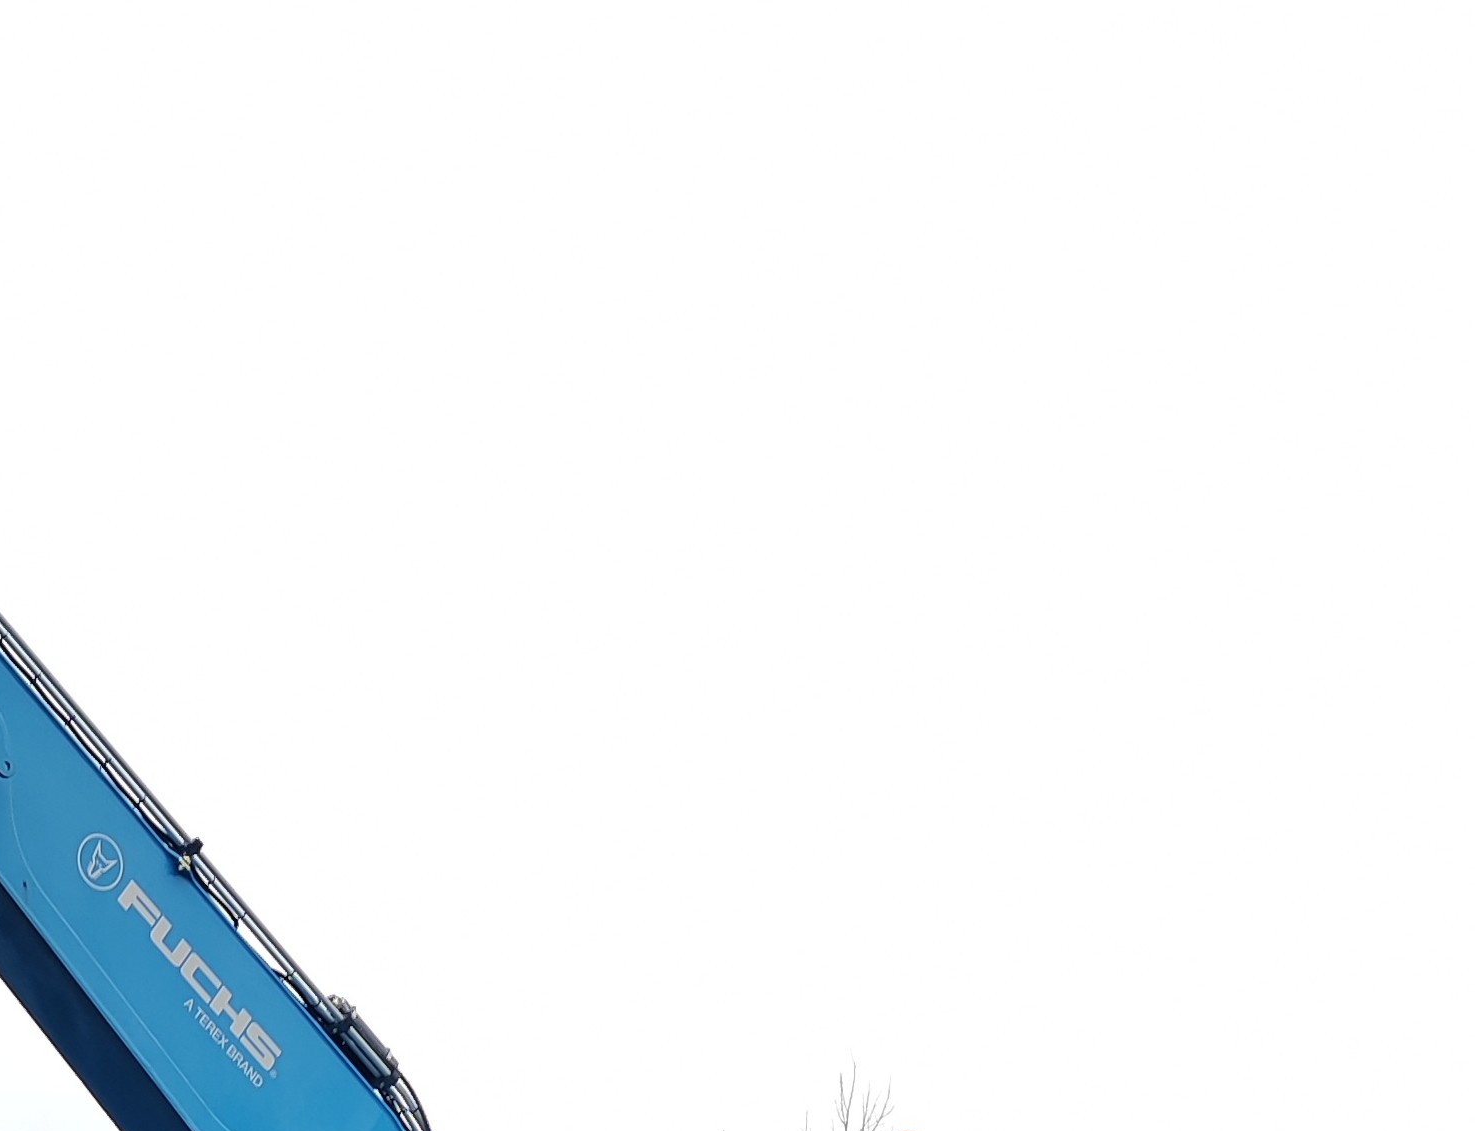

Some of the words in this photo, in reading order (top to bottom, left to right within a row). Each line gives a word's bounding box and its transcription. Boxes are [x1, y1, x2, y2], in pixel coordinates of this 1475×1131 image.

[117, 879, 282, 1072] FUCHS
[183, 998, 194, 1013] A
[194, 1006, 229, 1050] TEREX
[226, 1044, 264, 1088] BRAND
